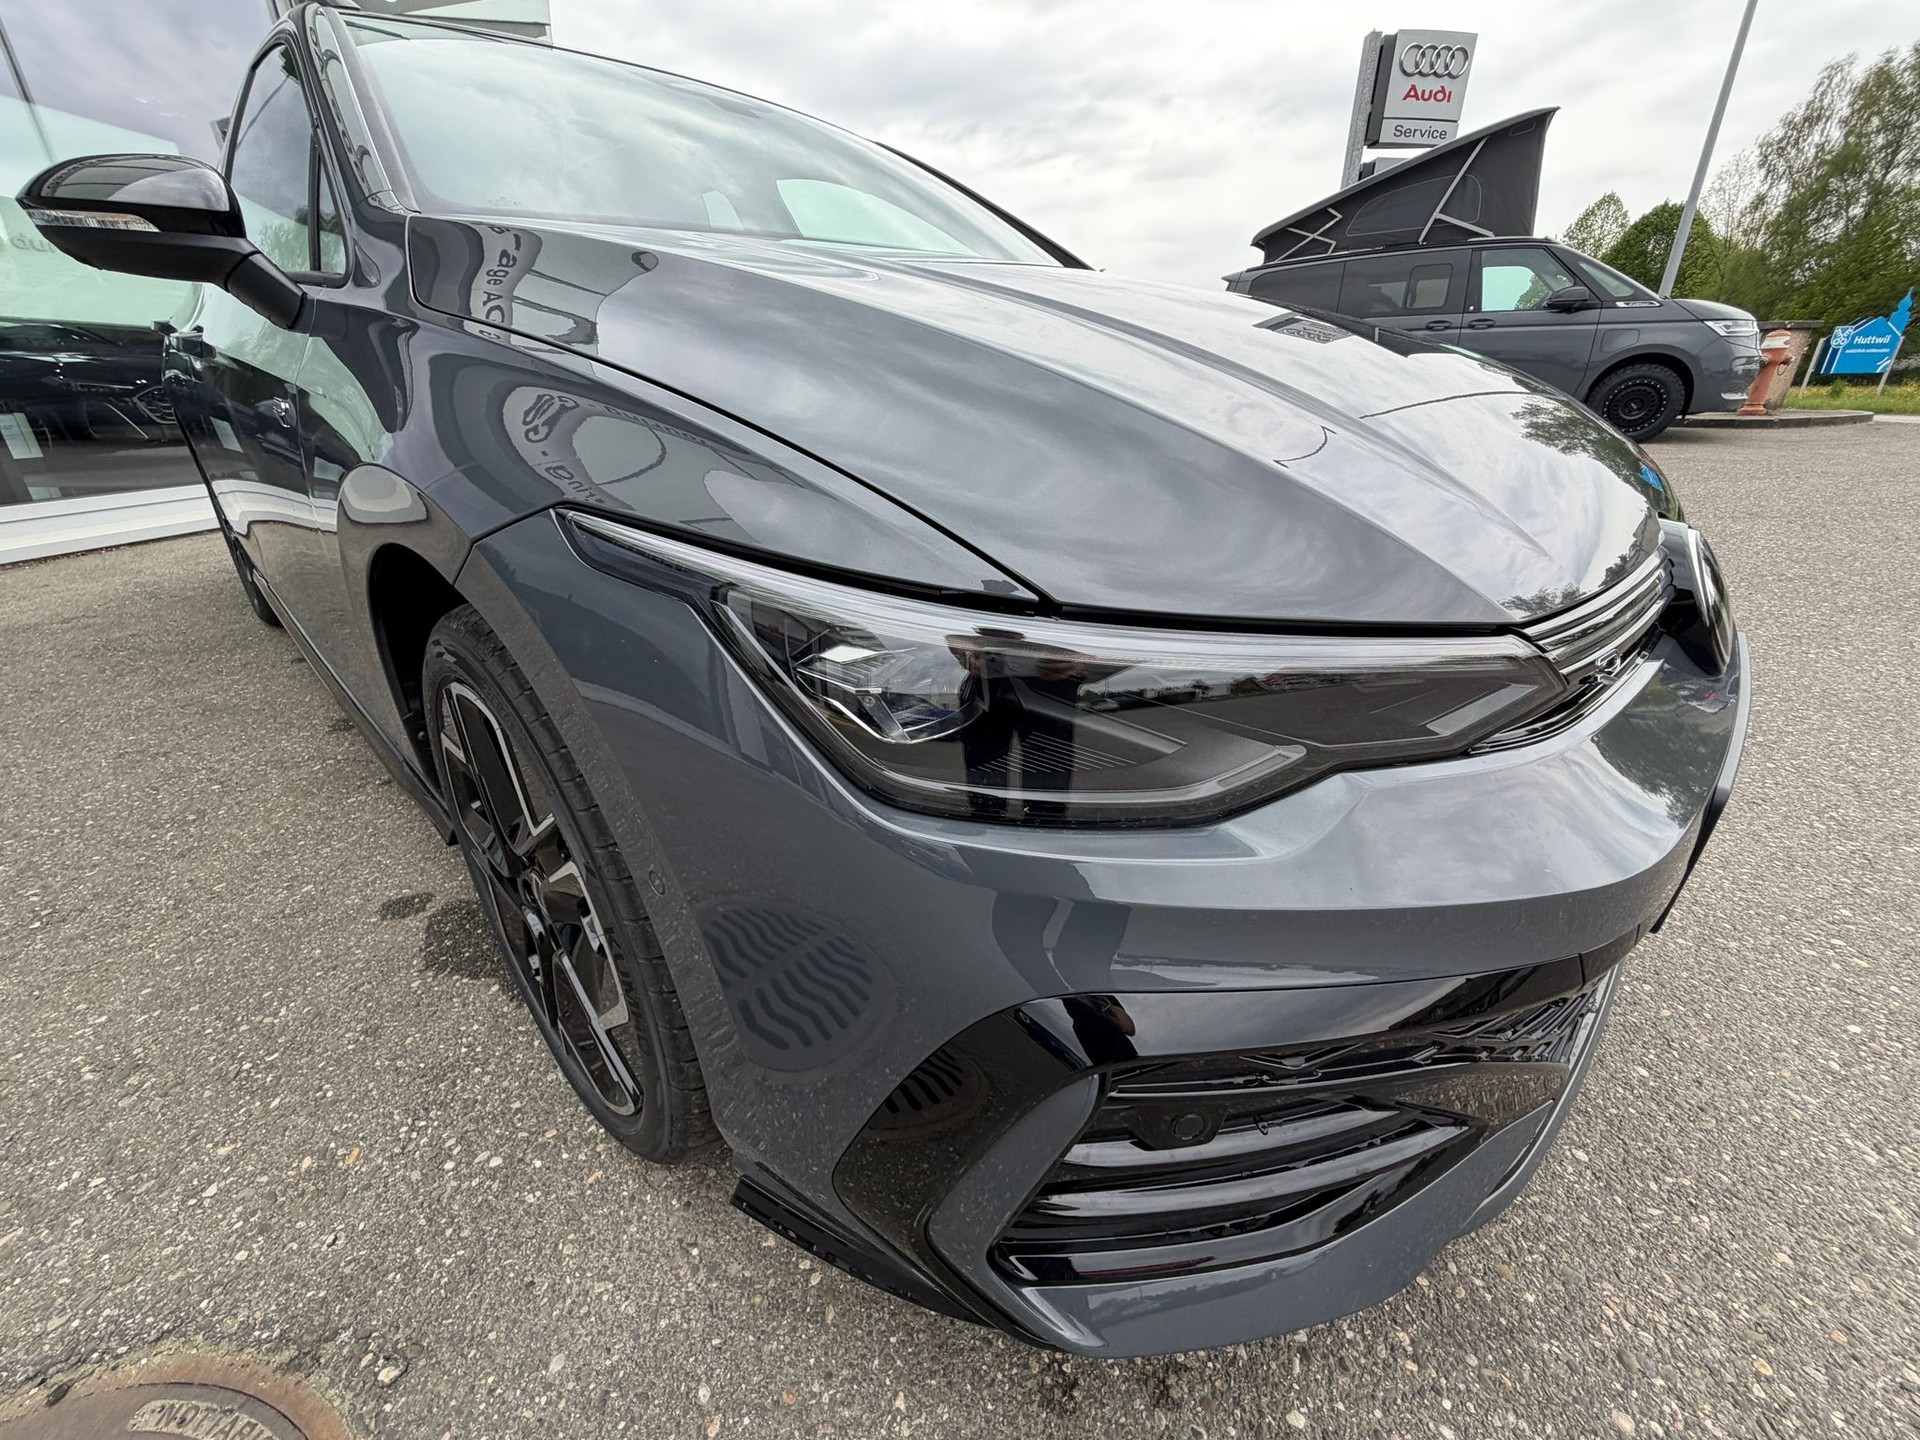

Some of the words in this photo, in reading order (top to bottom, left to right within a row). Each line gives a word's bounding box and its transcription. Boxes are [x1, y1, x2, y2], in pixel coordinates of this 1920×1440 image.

[1402, 84, 1452, 103] Audi
[1393, 124, 1448, 140] Service
[1853, 335, 1891, 344] Huttwil
